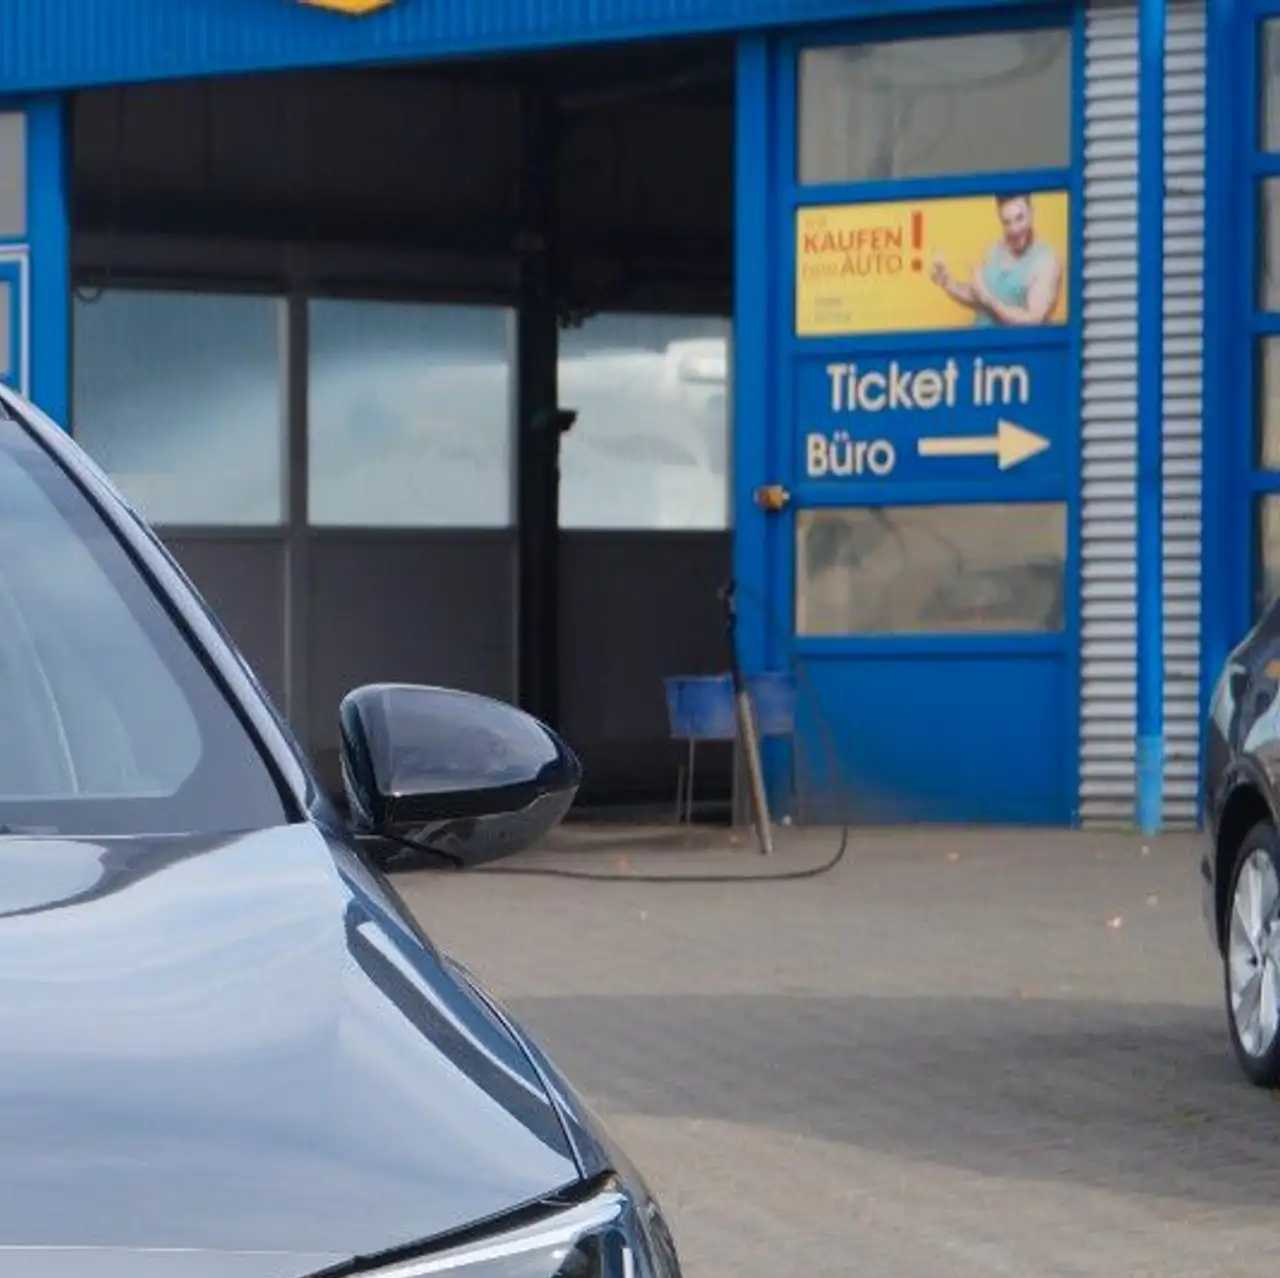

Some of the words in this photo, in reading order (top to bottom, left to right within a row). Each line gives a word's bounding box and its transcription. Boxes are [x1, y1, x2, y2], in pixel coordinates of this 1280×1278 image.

[803, 225, 903, 255] KAUFEN
[840, 252, 903, 277] AUTO
[826, 357, 958, 412] Ticket
[973, 356, 1030, 406] im
[806, 431, 896, 477] Büro
